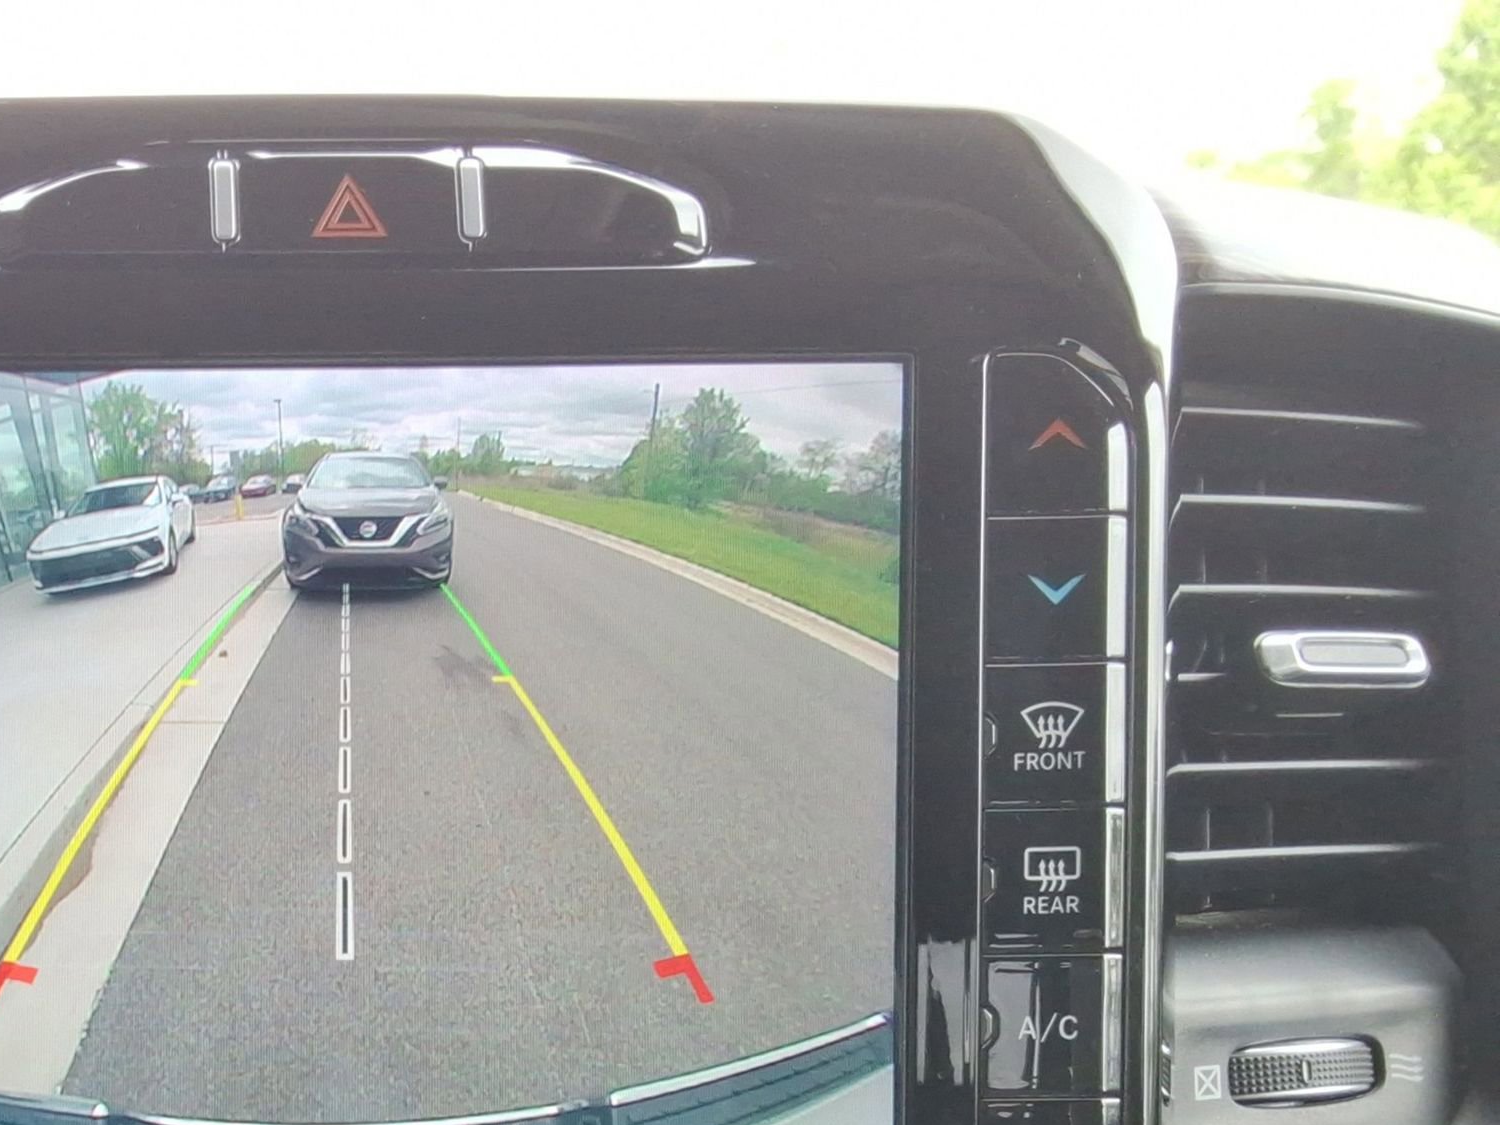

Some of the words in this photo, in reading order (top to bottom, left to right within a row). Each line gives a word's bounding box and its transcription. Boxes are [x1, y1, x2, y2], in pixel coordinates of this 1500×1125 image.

[1013, 751, 1086, 771] FRONT
[1022, 896, 1080, 915] REAR
[1018, 1012, 1079, 1042] A/C
